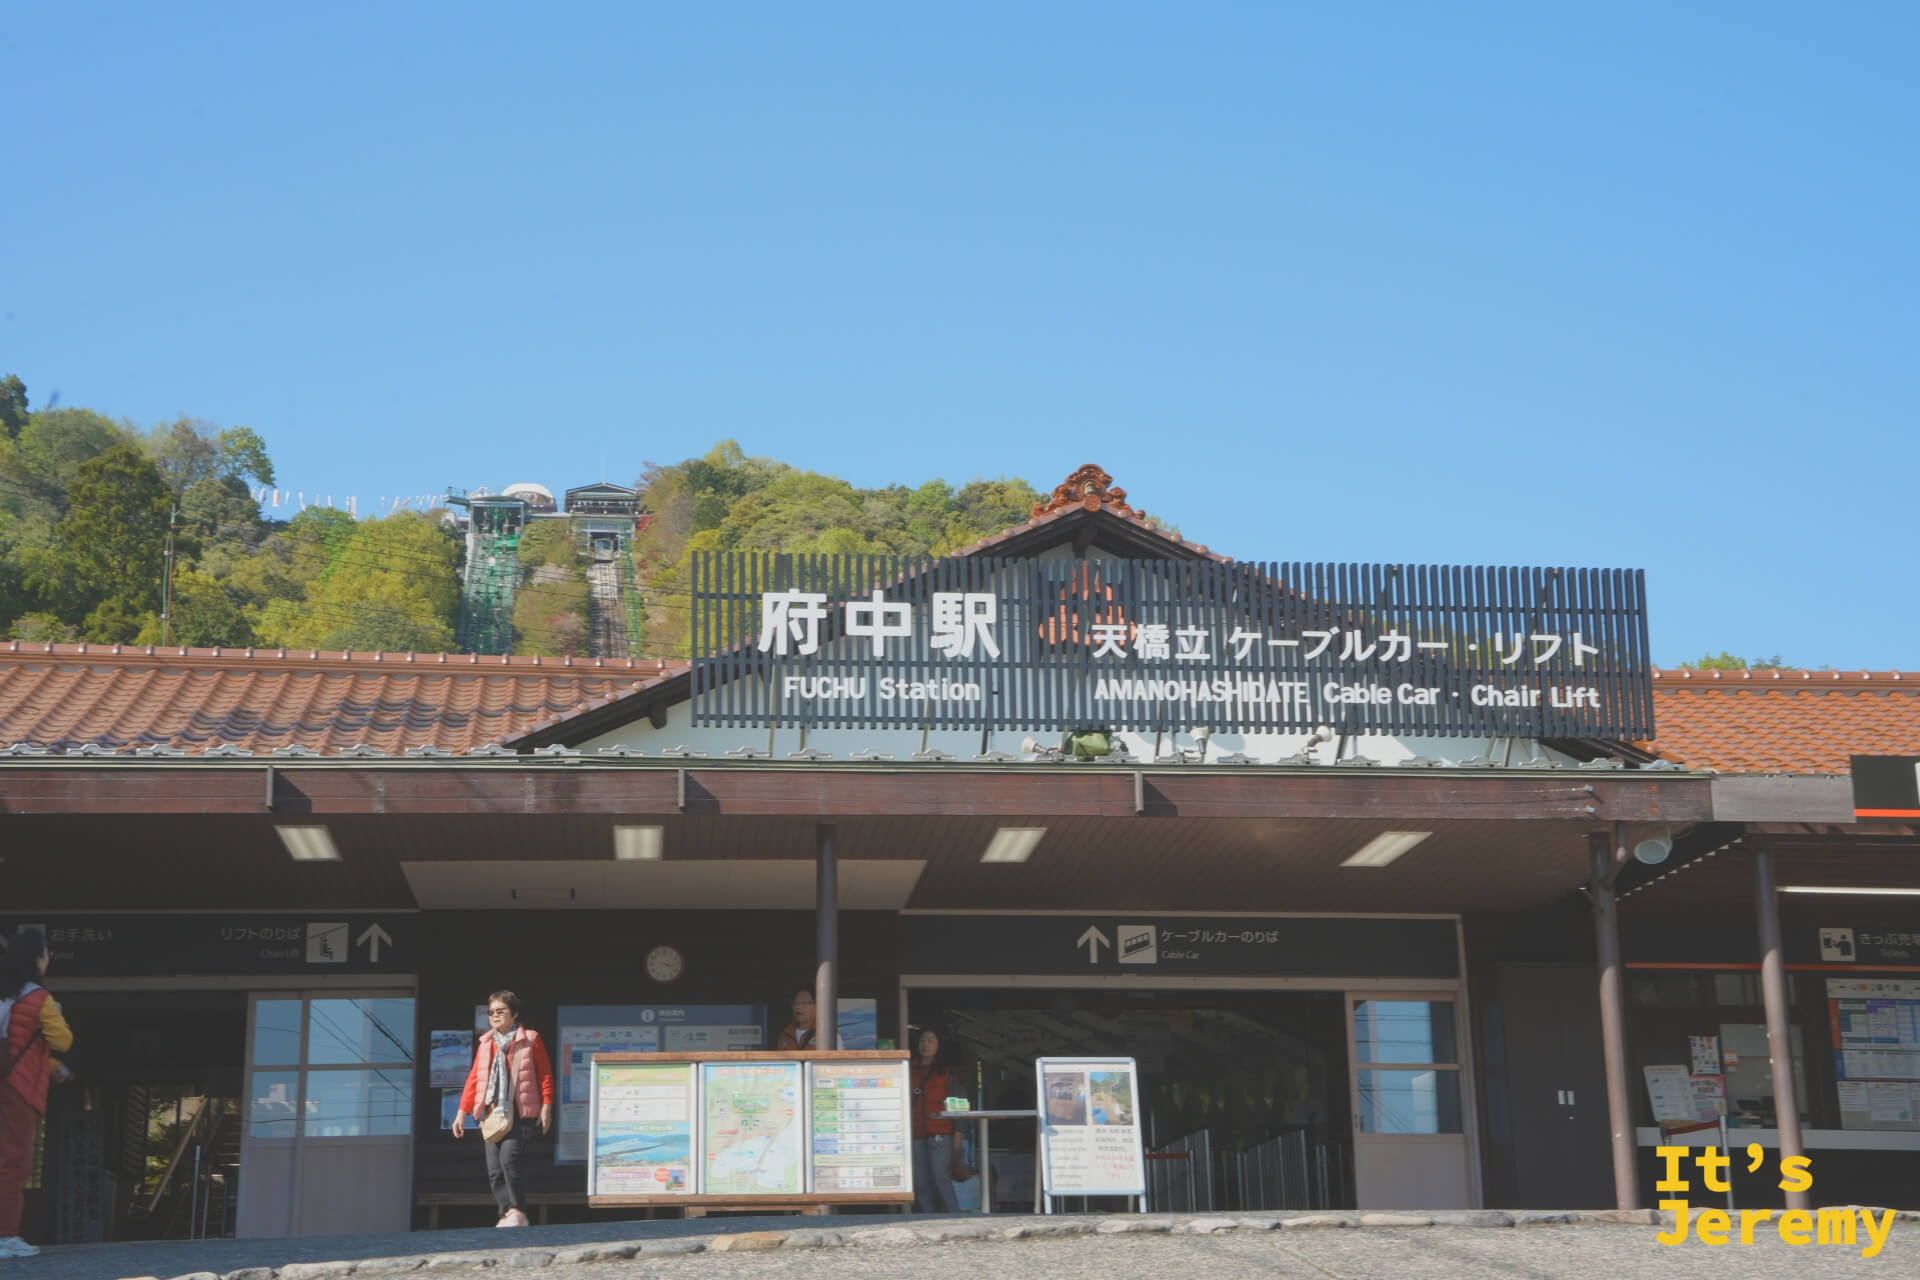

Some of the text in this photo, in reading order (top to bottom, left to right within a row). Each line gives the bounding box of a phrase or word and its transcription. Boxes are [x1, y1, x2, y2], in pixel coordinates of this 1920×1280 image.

[758, 588, 1000, 658] 府中駅
[1091, 624, 1211, 661] 天橋立
[784, 677, 981, 701] FUCHU Station
[1094, 678, 1309, 704] AMANOHASHIDATE
[1323, 682, 1392, 705] Cable
[1397, 683, 1440, 706] Car
[1471, 684, 1541, 707] Chair
[1551, 686, 1601, 708] Lift
[221, 927, 301, 942] リフトのりば
[1161, 929, 1280, 944] ケーブルカーのりば
